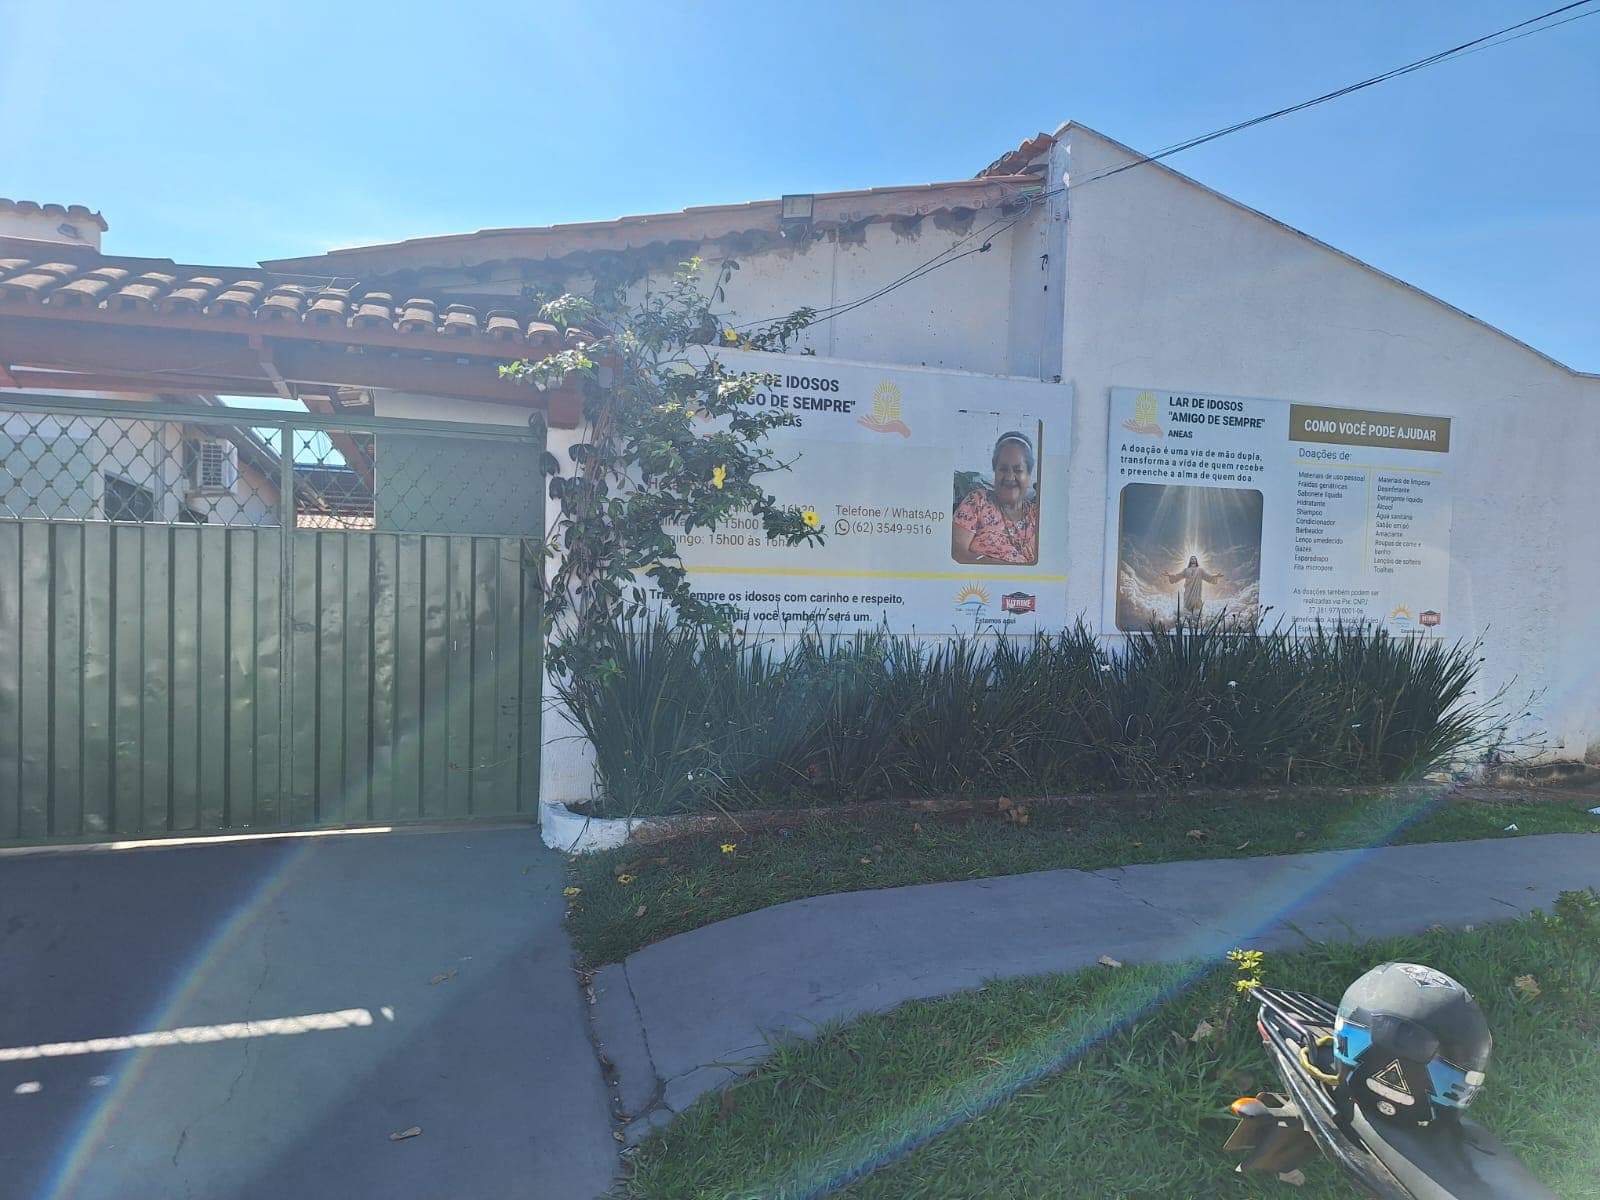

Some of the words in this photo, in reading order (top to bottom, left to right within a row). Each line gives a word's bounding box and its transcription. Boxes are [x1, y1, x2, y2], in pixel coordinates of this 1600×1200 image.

[786, 375, 840, 393] IDOSOS
[770, 394, 789, 409] DE
[793, 396, 856, 413] SEMPRE"
[1169, 396, 1189, 408] LAR
[1191, 399, 1205, 409] DE
[1207, 399, 1243, 412] IDOSOS
[1168, 411, 1205, 424] "AMIGO
[1208, 414, 1221, 425] DE
[1222, 415, 1266, 429] SEMPRE"
[1168, 429, 1193, 439] ANEAS
[1304, 418, 1337, 434] COMO
[1339, 420, 1367, 436] VOCÊ
[1368, 425, 1396, 438] PODE
[1397, 426, 1437, 442] AJUDAR
[1121, 443, 1127, 452] A
[1129, 444, 1162, 455] doação
[1163, 446, 1169, 454] é
[1171, 448, 1188, 456] uma
[1190, 448, 1204, 457] via
[1205, 449, 1216, 458] de
[1217, 450, 1235, 459] mão
[1237, 451, 1263, 462] dupla,
[1298, 447, 1337, 460] Doações
[1339, 449, 1352, 460] de:
[1120, 455, 1170, 466] transforma
[1172, 459, 1177, 467] a
[1179, 457, 1197, 468] vida
[1199, 459, 1209, 468] de
[1211, 461, 1234, 471] quem
[1235, 462, 1265, 472] recebe
[1127, 467, 1169, 478] preenche
[1177, 469, 1198, 479] alma
[1200, 471, 1210, 480] de
[1212, 472, 1235, 482] quem
[1237, 472, 1255, 483] doa.
[1344, 474, 1366, 482] pessoal
[1297, 489, 1323, 498] Sabonete
[1296, 499, 1326, 507] Hidratante
[836, 504, 881, 517] Telefone
[884, 507, 889, 518] /
[892, 507, 945, 521] WhatsApp
[1296, 508, 1323, 516] Shampoo
[724, 519, 759, 530] 15h00
[852, 520, 874, 535] (62)
[877, 523, 932, 535] 3549-9516
[1295, 517, 1336, 526] Condicionador
[1295, 526, 1324, 534] Barbeador
[709, 534, 744, 547] 15h00
[747, 535, 761, 547] às
[1295, 536, 1312, 544] Lenço
[1294, 545, 1312, 553] Gazes
[728, 592, 742, 602] os
[745, 590, 781, 602] idosos
[784, 594, 807, 602] com
[810, 592, 850, 603] carinho
[852, 594, 859, 603] e
[861, 593, 905, 606] respeito,
[753, 609, 779, 620] você
[782, 610, 825, 621] também
[828, 611, 851, 621] será
[853, 613, 872, 621] um.
